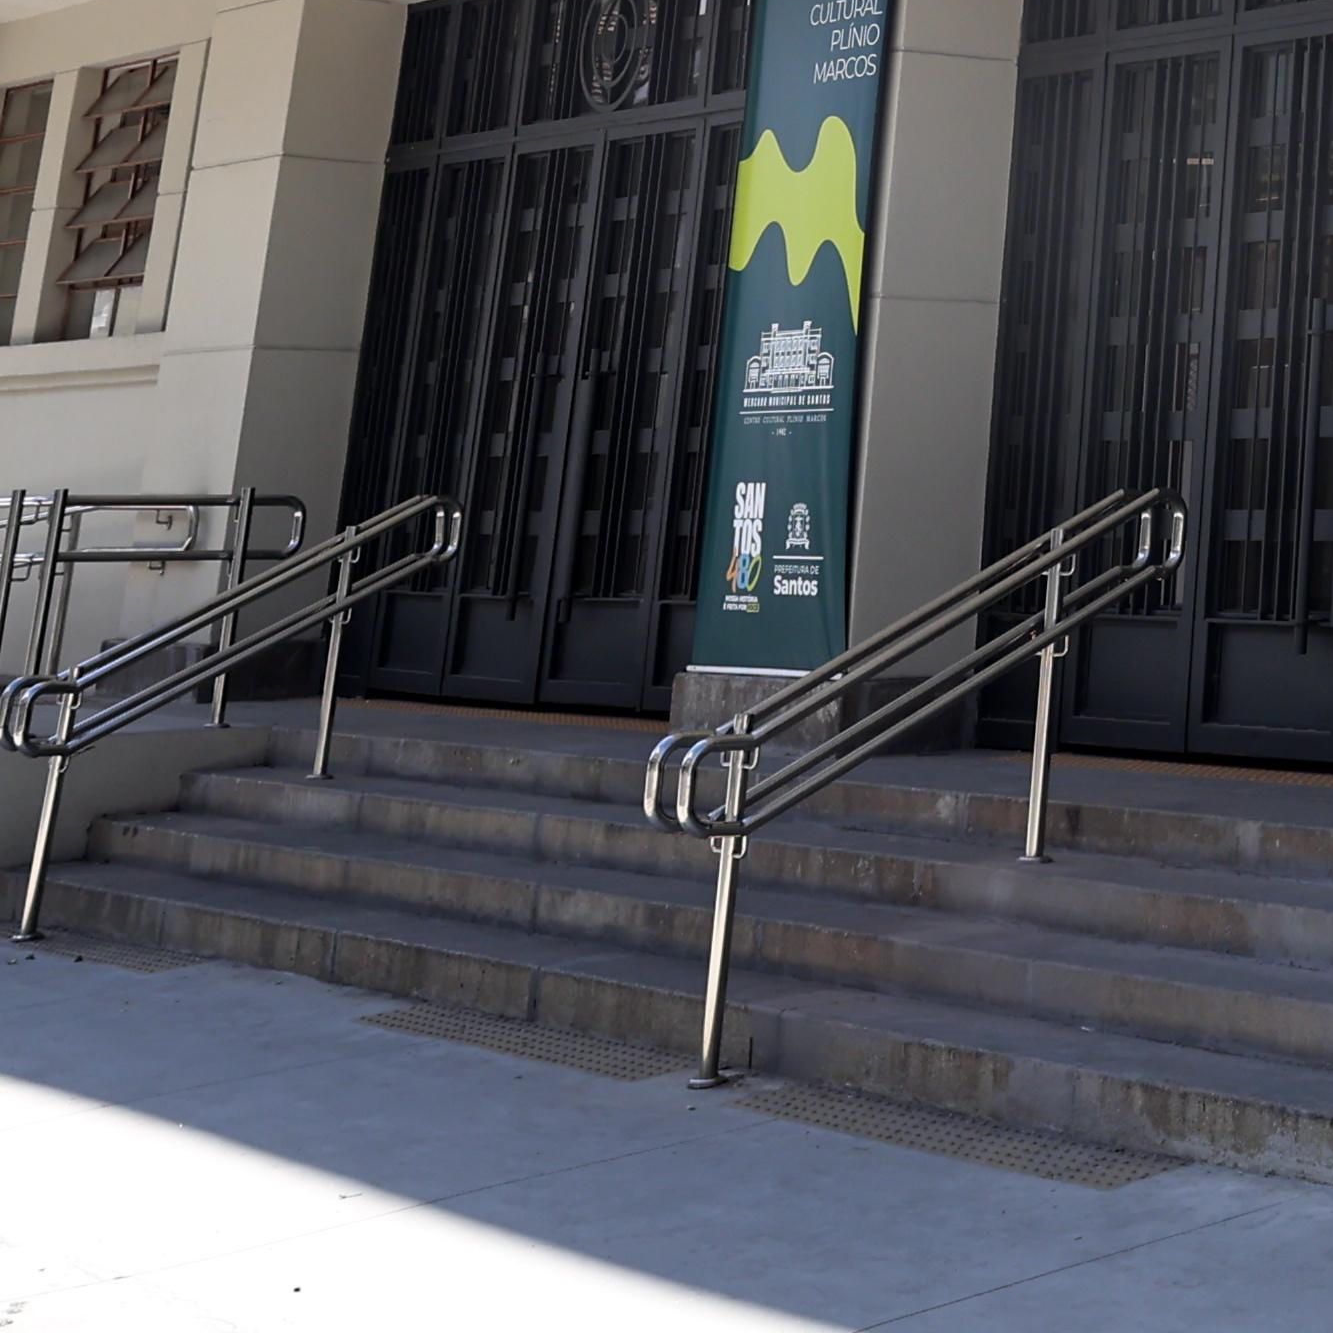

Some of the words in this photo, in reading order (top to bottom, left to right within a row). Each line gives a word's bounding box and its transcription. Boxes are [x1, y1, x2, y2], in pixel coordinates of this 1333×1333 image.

[831, 23, 880, 51] PLÍNIO
[813, 54, 877, 84] MARCOS
[726, 546, 761, 592] 480
[773, 574, 818, 596] Santos
